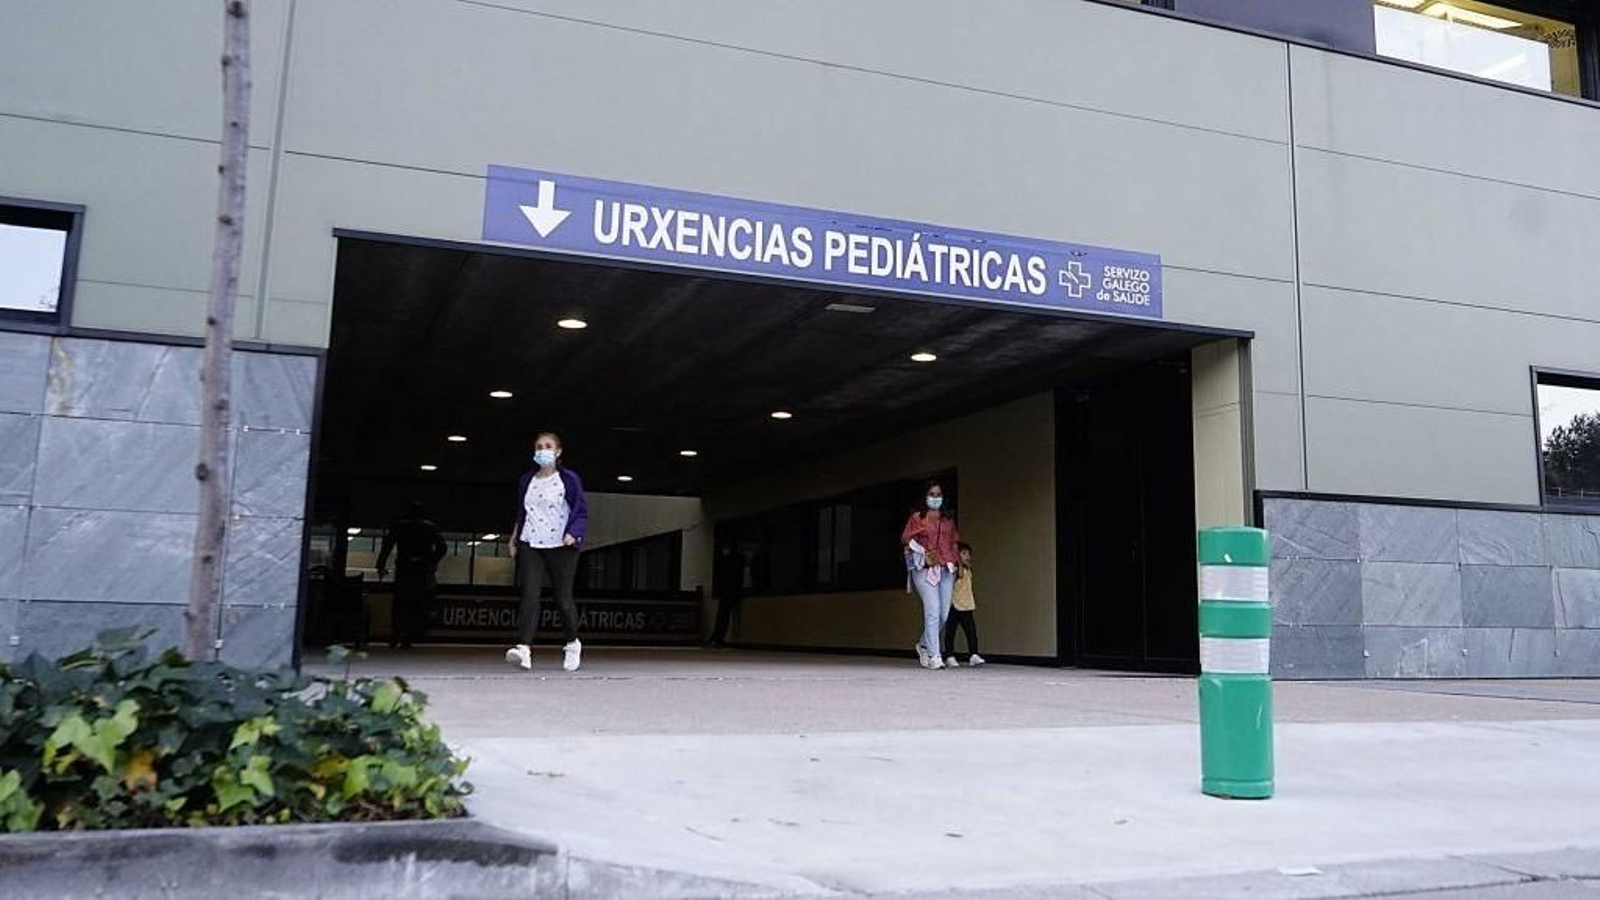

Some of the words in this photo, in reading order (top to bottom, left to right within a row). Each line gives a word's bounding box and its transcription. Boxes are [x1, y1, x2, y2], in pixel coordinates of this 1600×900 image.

[593, 199, 813, 268] URXENCIAS
[824, 231, 1047, 295] PEDIÁTRICAS
[1103, 266, 1150, 281] SERVIZO
[1102, 278, 1150, 293] GALEGO
[443, 607, 538, 627] URXENCI
[541, 606, 645, 629] PEÁTRICAS
